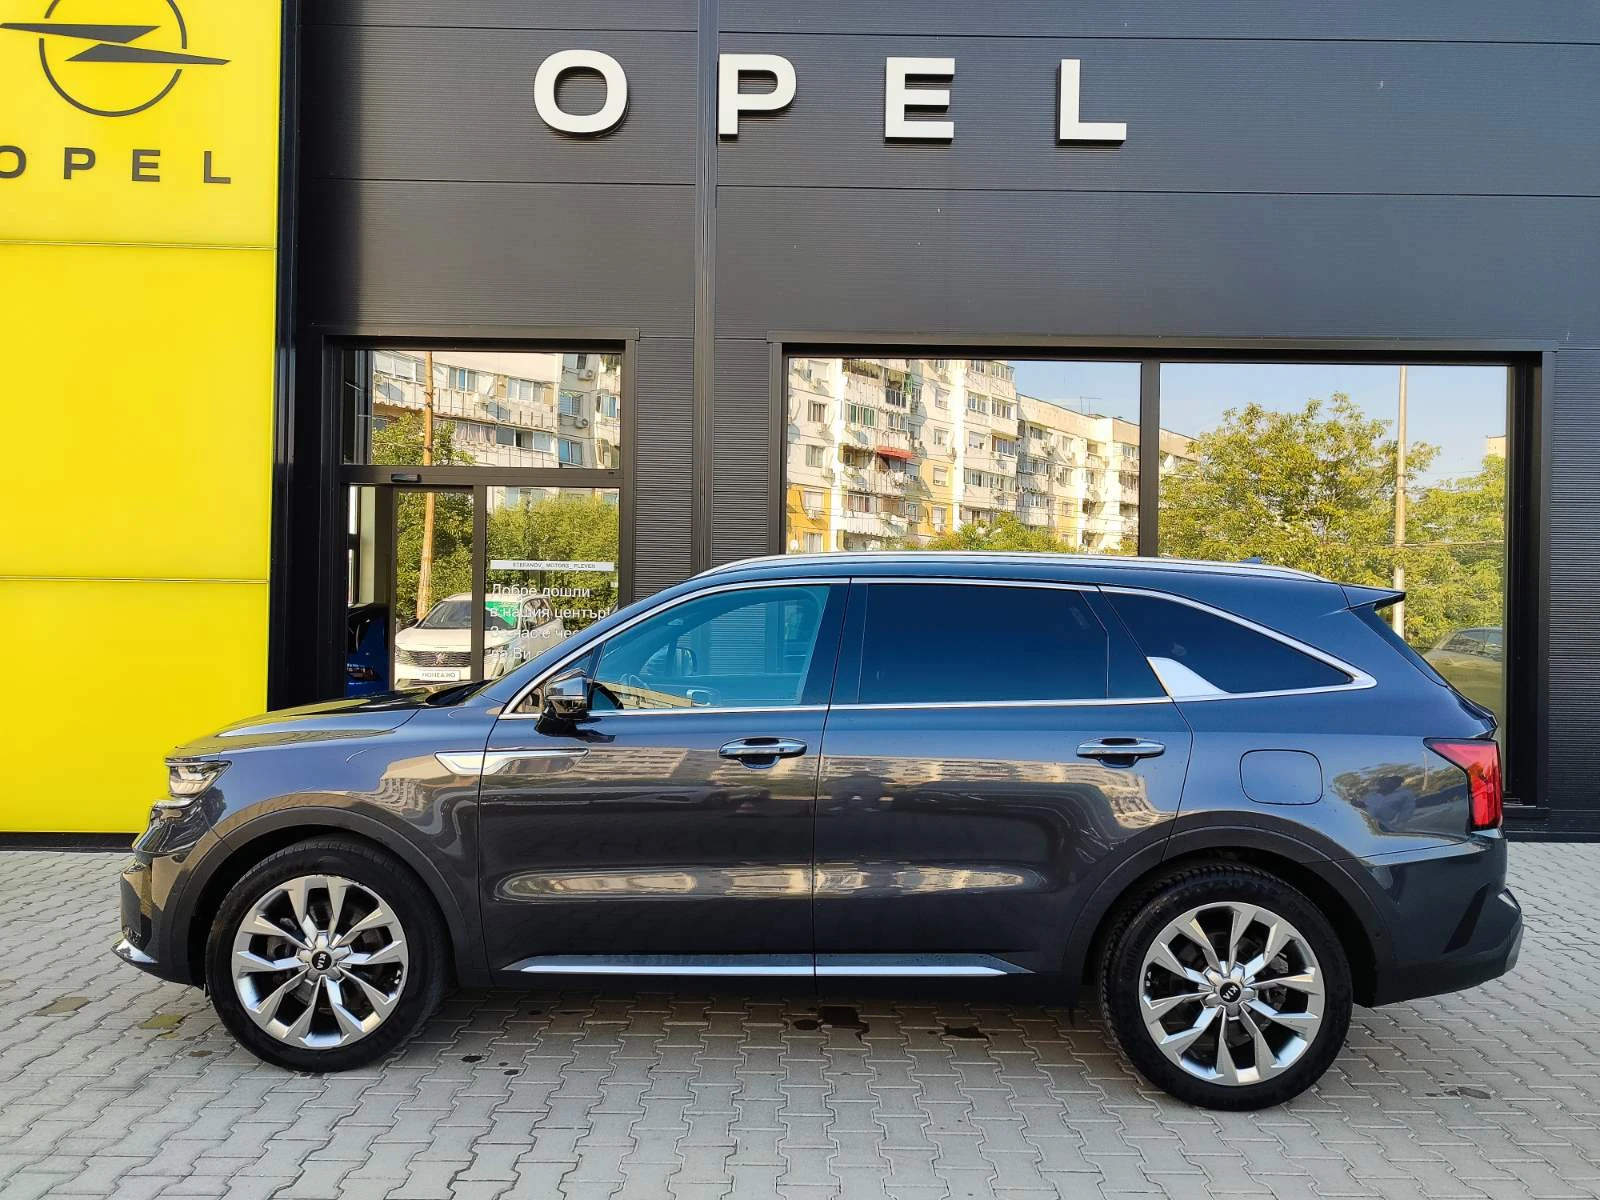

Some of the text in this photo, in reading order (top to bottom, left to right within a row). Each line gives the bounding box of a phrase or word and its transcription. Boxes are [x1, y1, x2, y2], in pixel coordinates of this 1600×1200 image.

[533, 49, 1128, 144] OPEL
[0, 145, 231, 184] OPEL
[492, 583, 592, 600] Добре дошли
[490, 608, 610, 622] в нашия център!
[1222, 985, 1239, 1000] KIA
